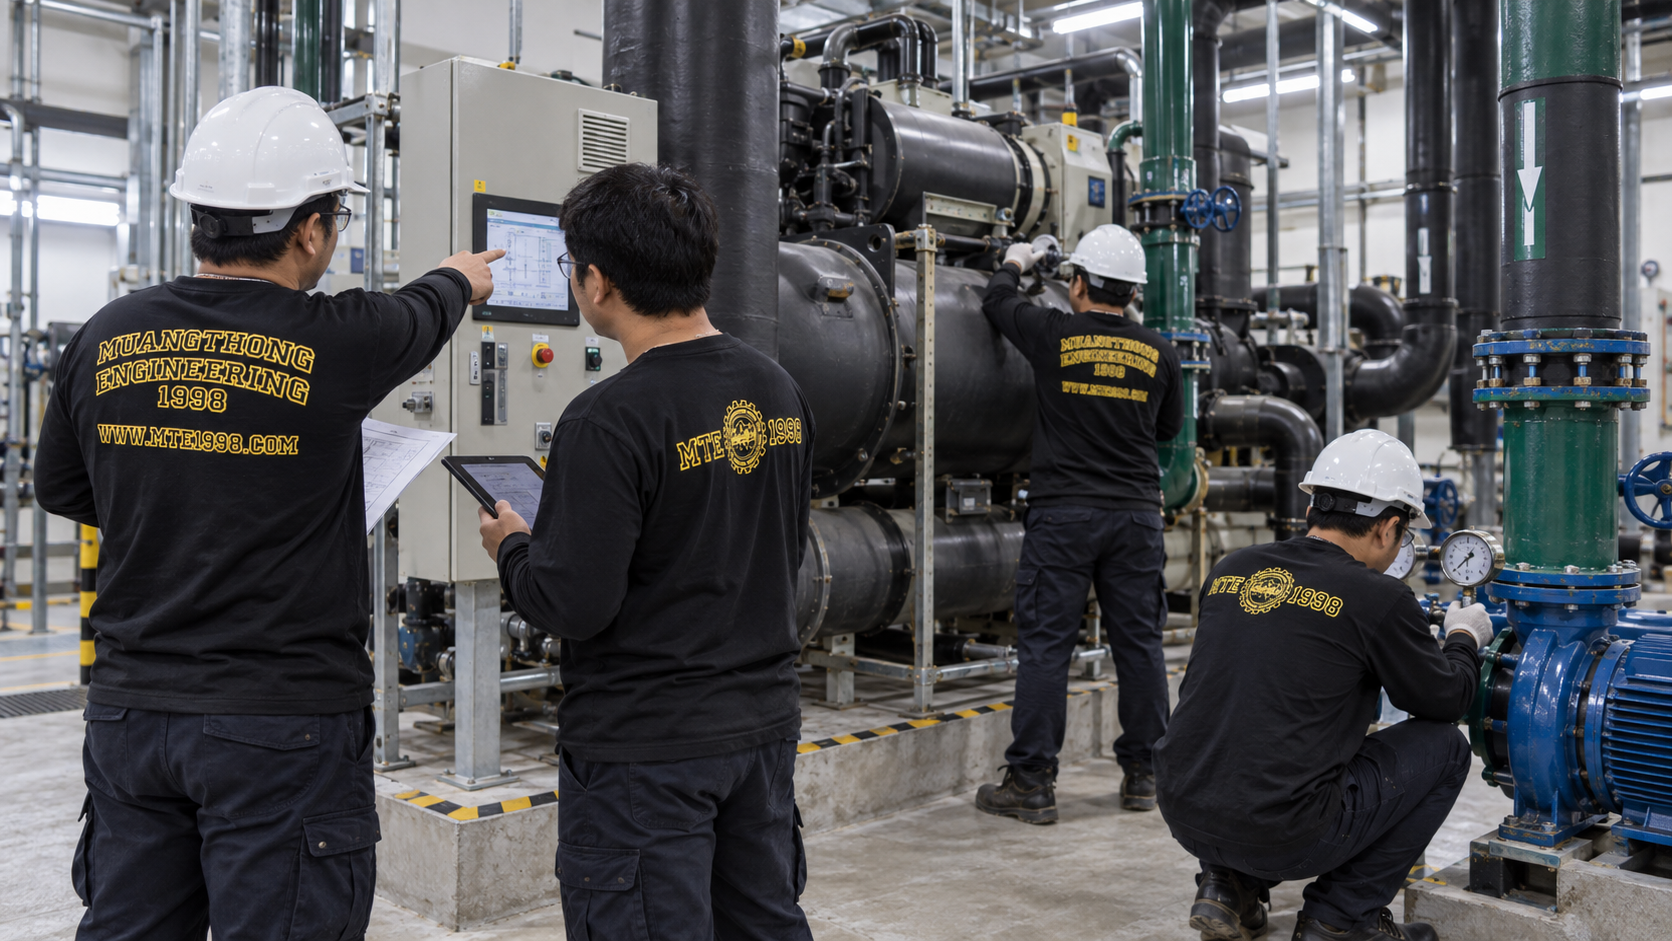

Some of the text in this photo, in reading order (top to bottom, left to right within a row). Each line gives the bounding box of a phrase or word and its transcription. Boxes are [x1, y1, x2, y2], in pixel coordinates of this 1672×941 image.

[97, 329, 315, 374] MUANGTHONG
[96, 357, 310, 406] ENGINEERING
[157, 385, 227, 413] 1998
[97, 424, 299, 455] WWW.MTE1998.COM
[676, 430, 725, 471] MTE
[1287, 586, 1343, 618] 1998
